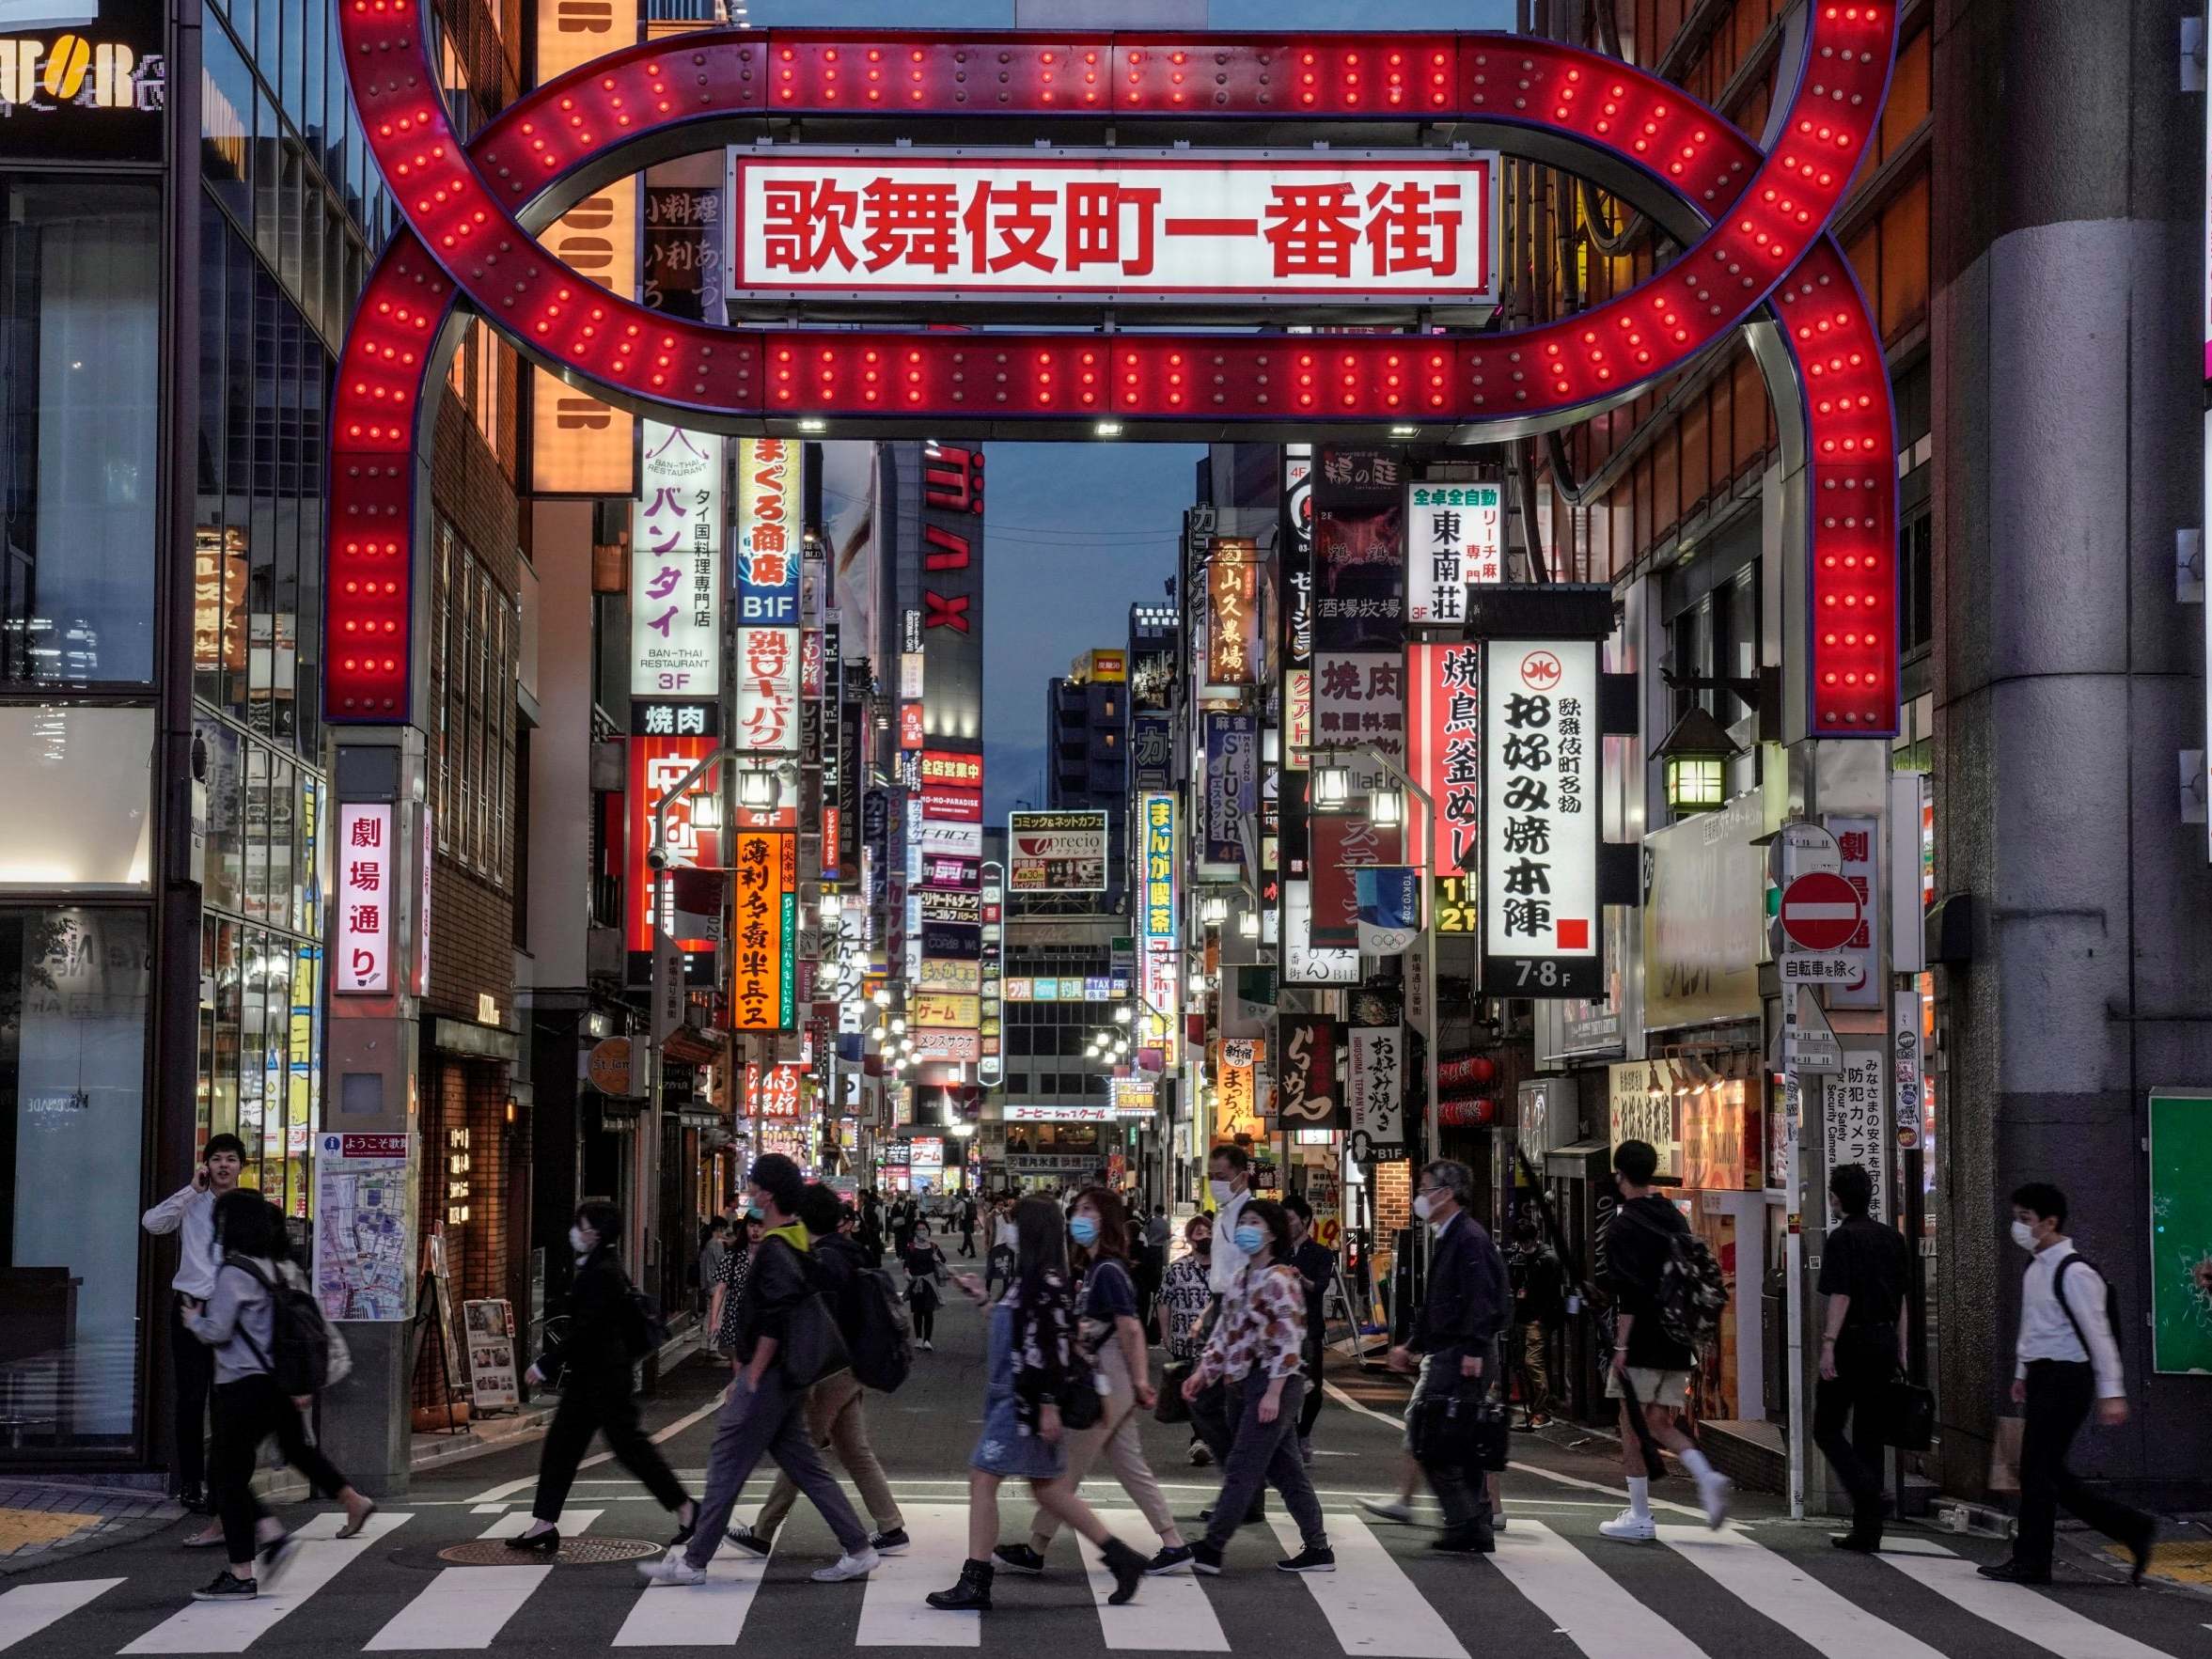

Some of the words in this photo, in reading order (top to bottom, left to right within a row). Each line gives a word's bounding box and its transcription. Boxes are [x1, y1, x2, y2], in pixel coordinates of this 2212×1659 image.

[763, 178, 1463, 277] 歌舞伎町一番街
[647, 464, 707, 477] RESTAURANT
[654, 459, 699, 469] BAN-THAI
[754, 438, 786, 585] まぐろ商店
[1414, 489, 1497, 507] 全卓全自動
[643, 488, 687, 638] バンタイ
[694, 489, 711, 628] タイ国料理専門店
[1432, 510, 1461, 619] 東南荘
[744, 597, 793, 618] B1F
[1219, 570, 1244, 670] 山久農場
[1413, 607, 1428, 619] 3F
[640, 659, 709, 668] RESTAURANT
[658, 673, 690, 690] 3F
[1321, 660, 1402, 700] 焼肉
[646, 706, 705, 735] 焼肉
[922, 759, 979, 778] 全店営業中
[1558, 698, 1582, 814] 歌舞伎町名物
[1014, 817, 1104, 828] コミック&ネットカフェ
[1503, 693, 1552, 938] お好み焼本陣
[1148, 804, 1174, 932] まんが喫茶
[349, 818, 381, 977] 劇場通り
[1786, 961, 1857, 978] 自転車を除く
[1827, 1084, 1837, 1122] Security
[1838, 1112, 1847, 1142] Safety
[1378, 1149, 1403, 1159] B1F
